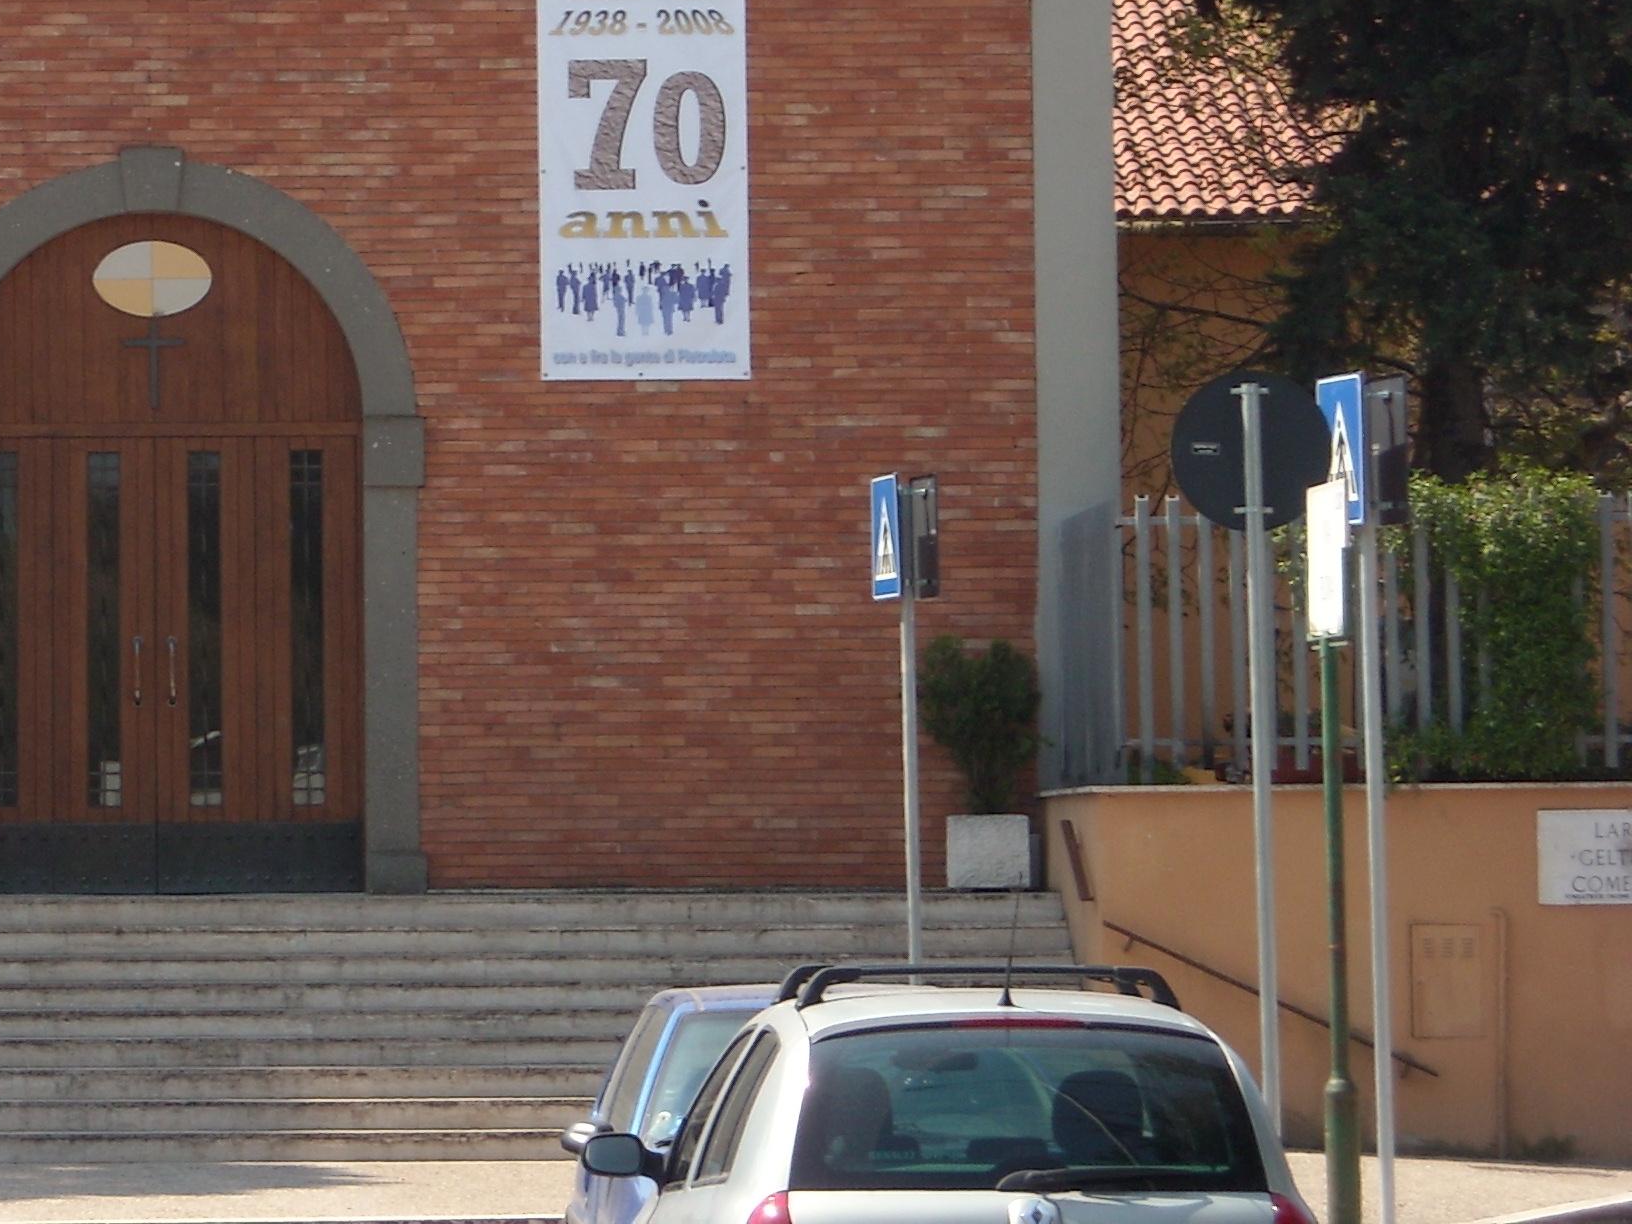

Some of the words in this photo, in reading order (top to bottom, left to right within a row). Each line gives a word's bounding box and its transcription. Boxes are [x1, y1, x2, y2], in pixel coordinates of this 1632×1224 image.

[548, 10, 627, 36] 1938
[656, 9, 736, 36] 2008
[567, 58, 727, 190] 70
[558, 198, 730, 239] anni
[1578, 848, 1632, 866] GELT
